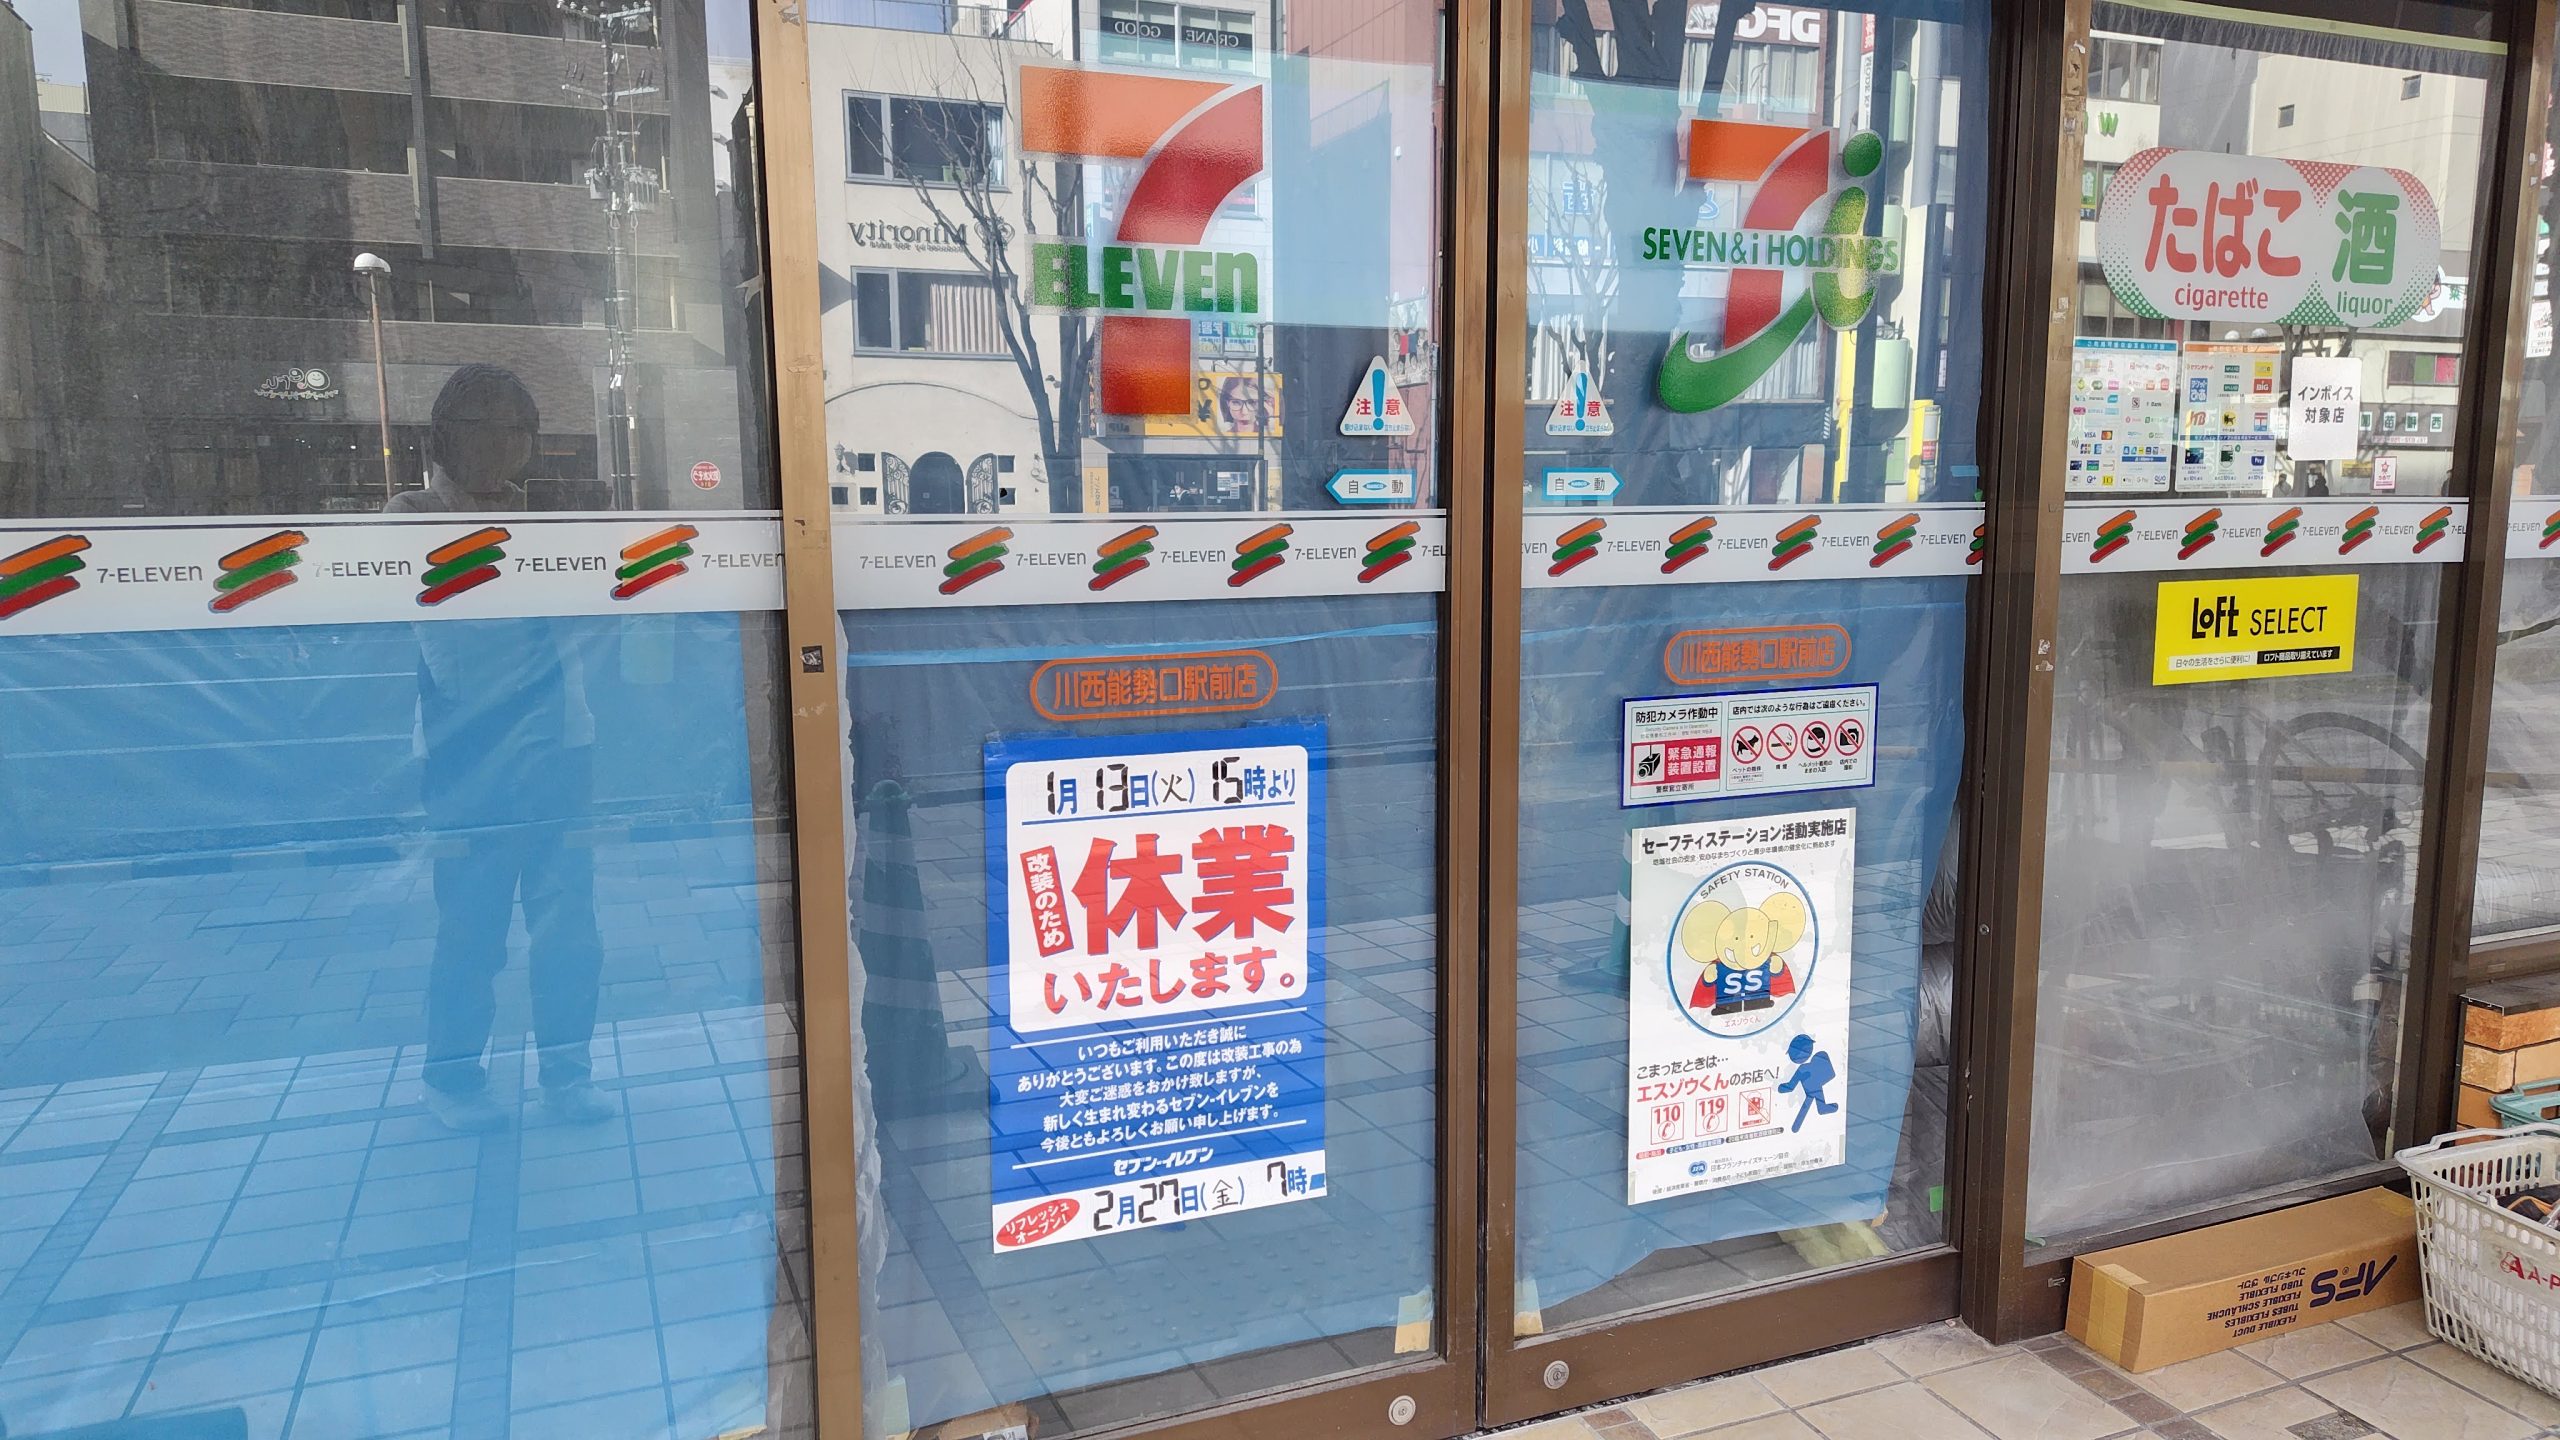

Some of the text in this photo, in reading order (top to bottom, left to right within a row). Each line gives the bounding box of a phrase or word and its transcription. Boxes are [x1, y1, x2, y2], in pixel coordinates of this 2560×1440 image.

[2144, 173, 2303, 278] たばこ
[2332, 189, 2401, 287] 酒
[1766, 235, 1899, 274] HOLDINGS
[2174, 283, 2394, 319] cigarette liquor
[2298, 385, 2354, 401] インボイス
[2304, 407, 2345, 424] 対象店
[2249, 605, 2328, 637] SELECT
[1680, 635, 1836, 674] 川西能勢口駅前店
[1053, 663, 1258, 710] 川西能勢口駅前店
[1635, 707, 1718, 724] 防犯カメラ作動中
[1732, 699, 1867, 716] 店内では次のような行為はご遠慮ください。
[1667, 744, 1717, 761] 緊急通報
[1667, 759, 1717, 776] 装置設置
[1641, 817, 1847, 855] セーフティステーション活動実施店
[1024, 852, 1066, 948] 改装のため
[1072, 824, 1296, 956] 休業
[1700, 868, 1789, 899] SAFETY STATION
[1043, 945, 1295, 1015] いたします。
[1077, 1024, 1247, 1062] いつもご利用いただき誠に
[1017, 1037, 1303, 1093] ありがとうございます。この度は改装工事の為
[1059, 1066, 1263, 1109] 大変ご迷惑をおかけ致しますが、
[1042, 1081, 1280, 1133] 新しく生まれ変わるセブン-イレブンを
[1653, 1097, 1725, 1125] 110 119
[1040, 1105, 1281, 1154] 今後ともよろしくお願い申し上げます。
[1005, 1201, 1070, 1234] リフレッシュ
[2239, 1278, 2304, 1302] TUBO FLEXIBLE
[2262, 1290, 2302, 1308] FLEXIBLE
[2225, 1302, 2300, 1329] TUBES FLEXIBLES
[2231, 1314, 2297, 1338] FLEXIBLE DUCT
